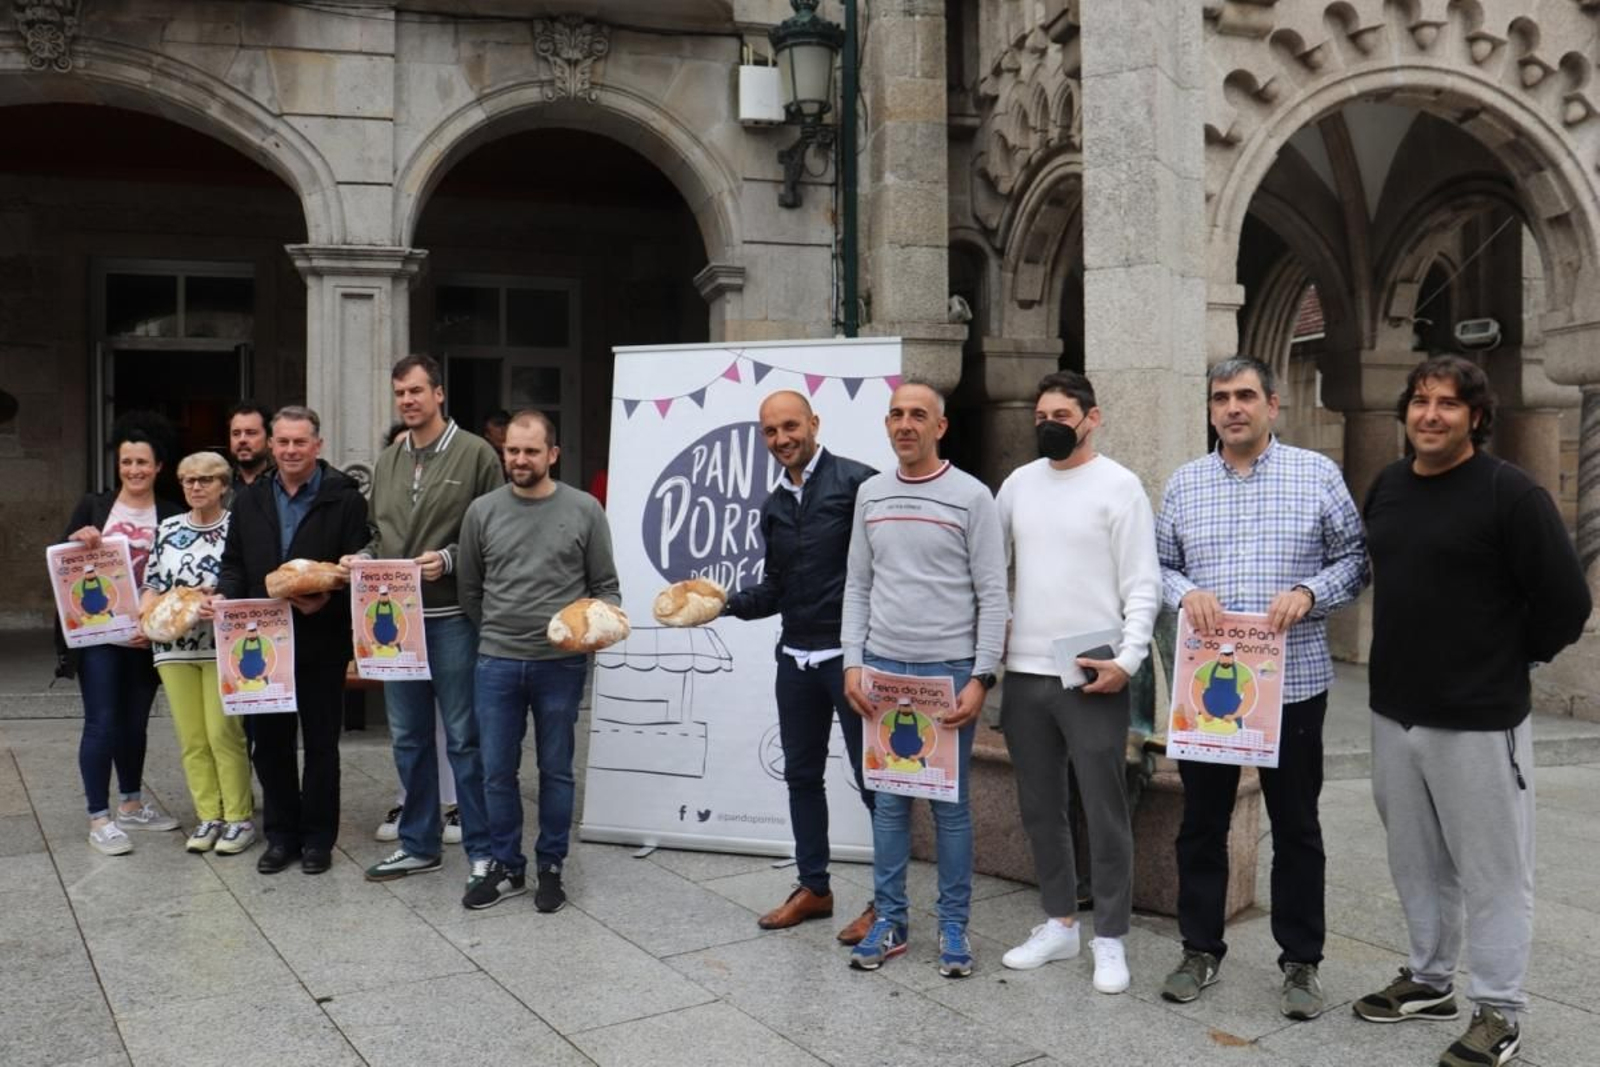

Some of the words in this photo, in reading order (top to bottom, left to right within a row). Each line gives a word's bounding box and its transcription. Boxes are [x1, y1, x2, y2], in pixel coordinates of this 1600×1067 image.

[692, 425, 756, 500] PAN
[655, 474, 762, 570] PORR
[1228, 626, 1246, 639] do
[1248, 627, 1276, 641] Pan
[1204, 640, 1220, 651] do
[1235, 642, 1280, 656] Porriño
[873, 681, 900, 694] Feira
[901, 685, 918, 696] do
[920, 686, 945, 698] Pan
